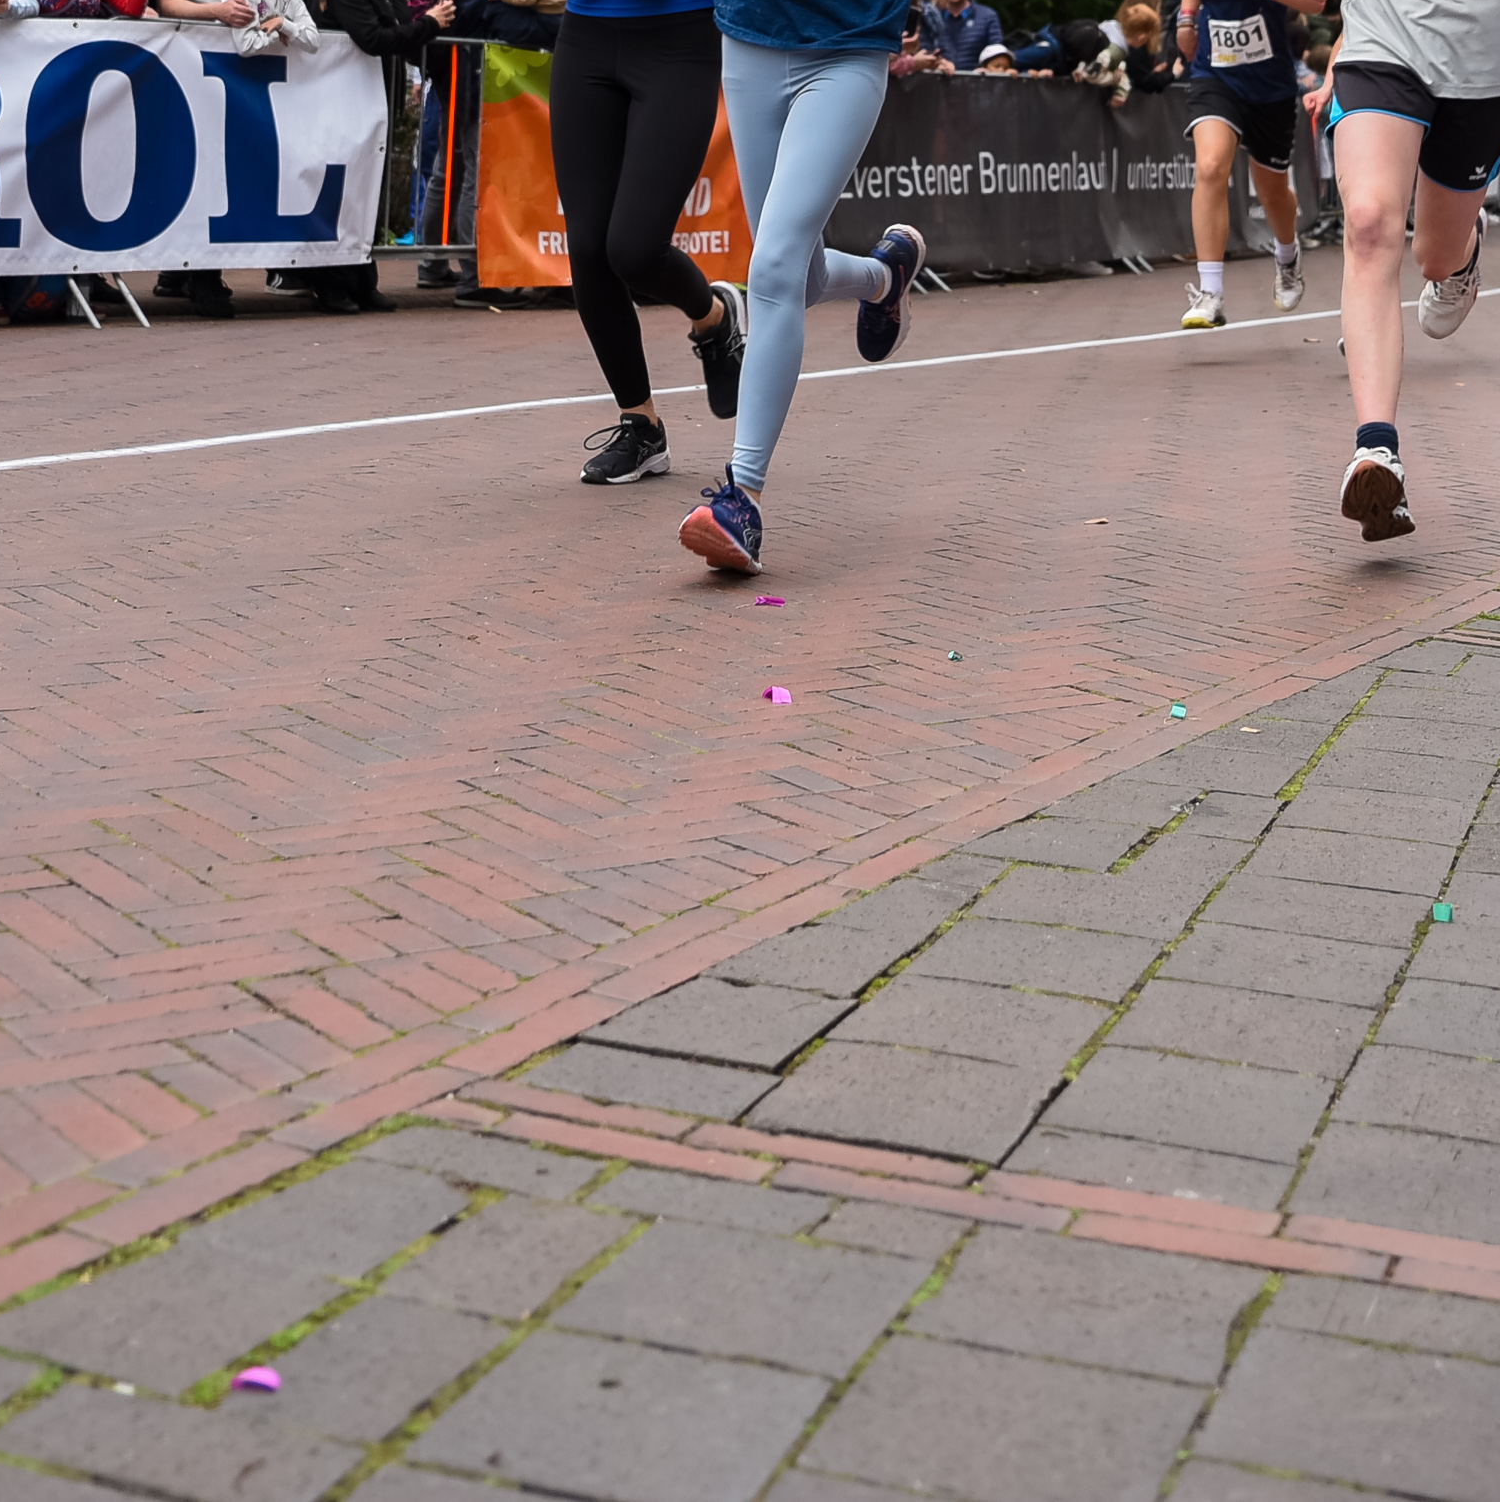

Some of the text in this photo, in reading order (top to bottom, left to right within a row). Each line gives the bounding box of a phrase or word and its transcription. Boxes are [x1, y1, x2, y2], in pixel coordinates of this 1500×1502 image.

[1213, 24, 1264, 49] 1801
[840, 156, 973, 199] verstener
[1126, 152, 1197, 191] unterstütz
